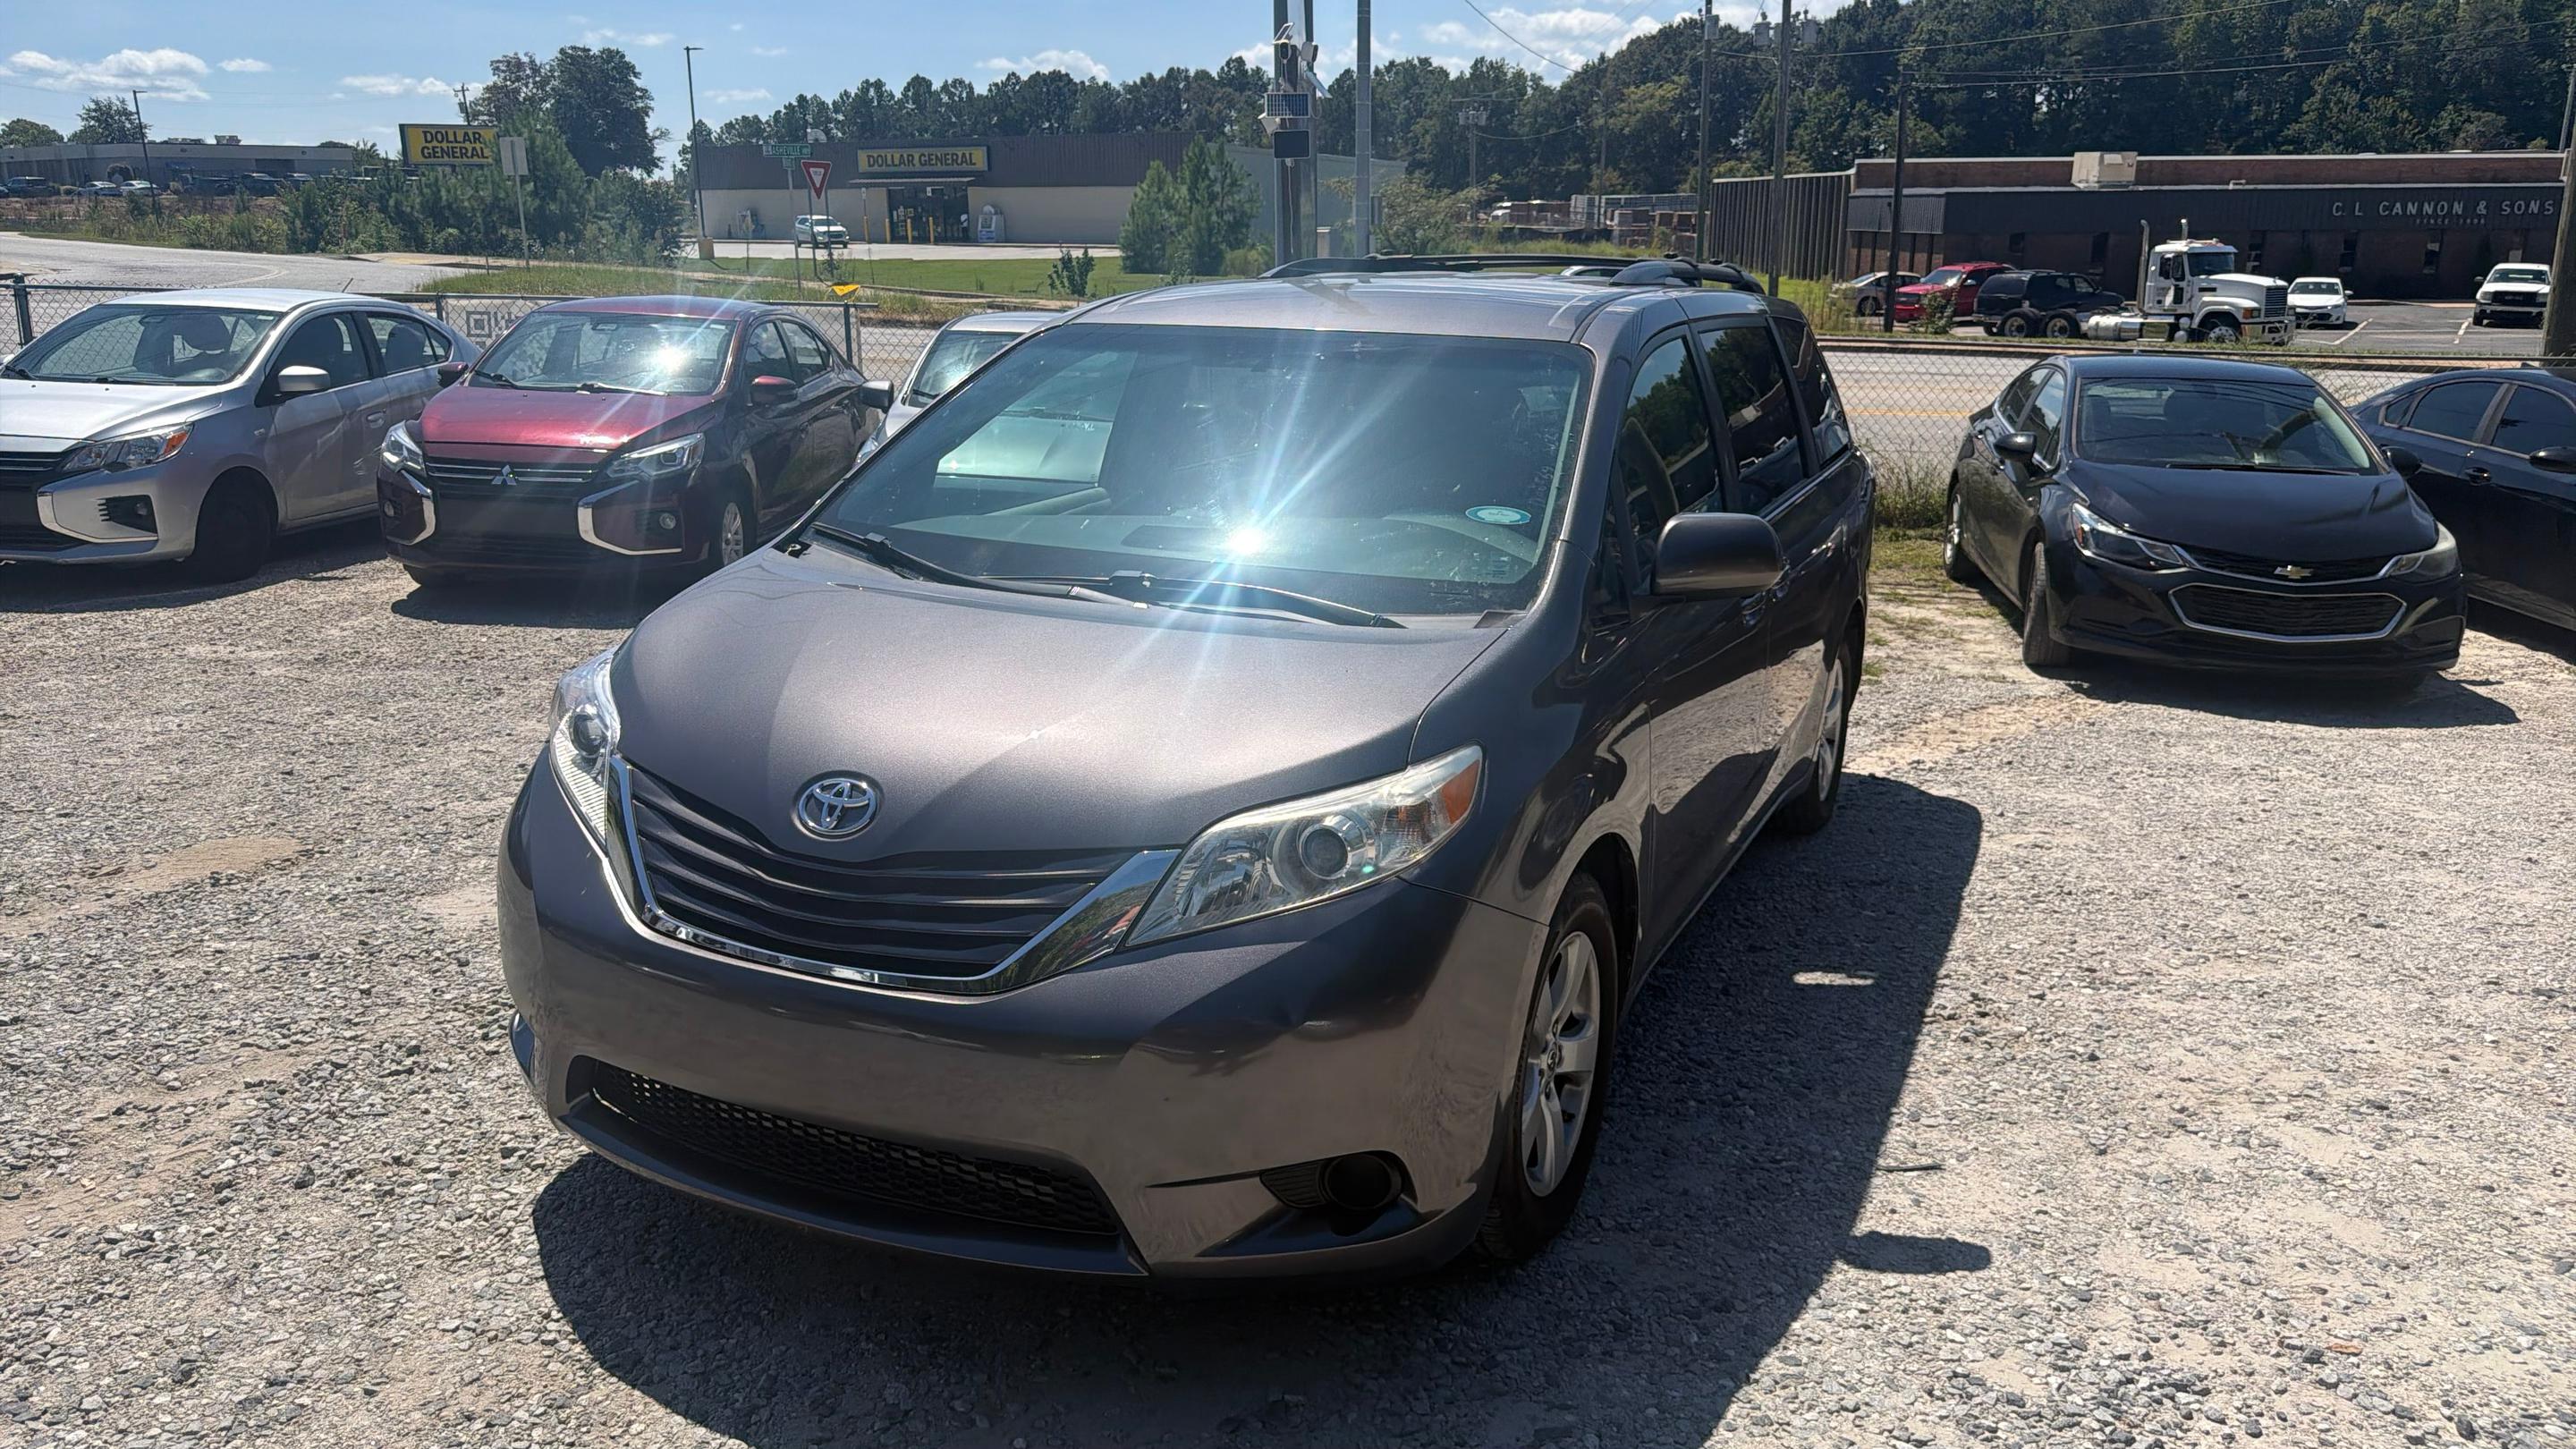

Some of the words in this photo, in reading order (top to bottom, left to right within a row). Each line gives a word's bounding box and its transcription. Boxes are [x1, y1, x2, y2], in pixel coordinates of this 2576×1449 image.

[421, 130, 482, 144] DOLLAR
[420, 146, 489, 159] GENERAL
[866, 154, 916, 167] DOLLAR
[918, 152, 977, 166] GENERAL
[2379, 201, 2463, 216] CANNON
[2476, 199, 2487, 215] &
[2500, 199, 2555, 215] SONS
